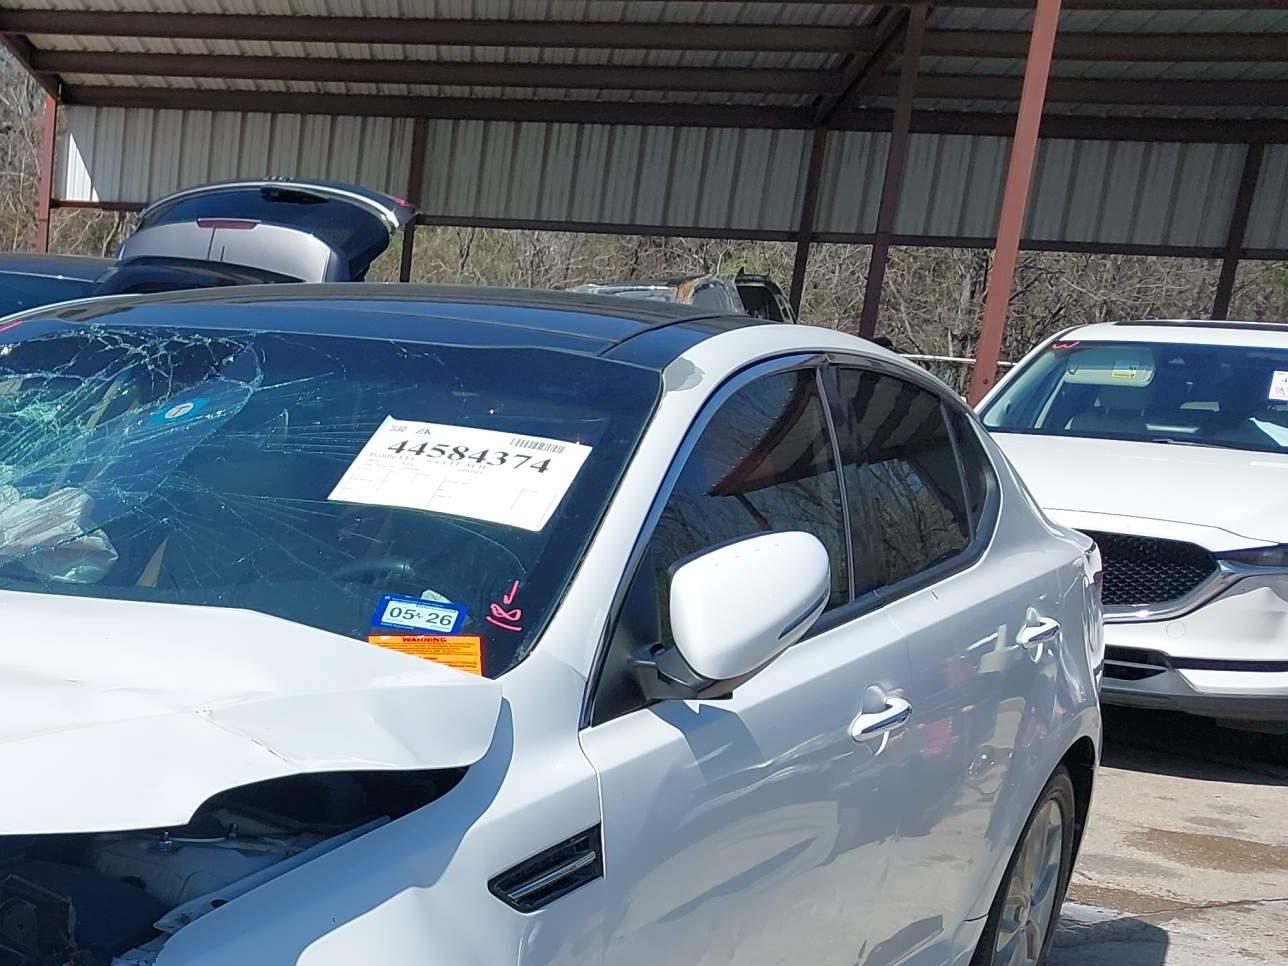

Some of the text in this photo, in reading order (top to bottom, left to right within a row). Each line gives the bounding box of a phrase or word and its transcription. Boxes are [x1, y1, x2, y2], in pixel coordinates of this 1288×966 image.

[387, 439, 552, 474] 44584374
[389, 606, 416, 621] 05
[425, 612, 454, 626] 26
